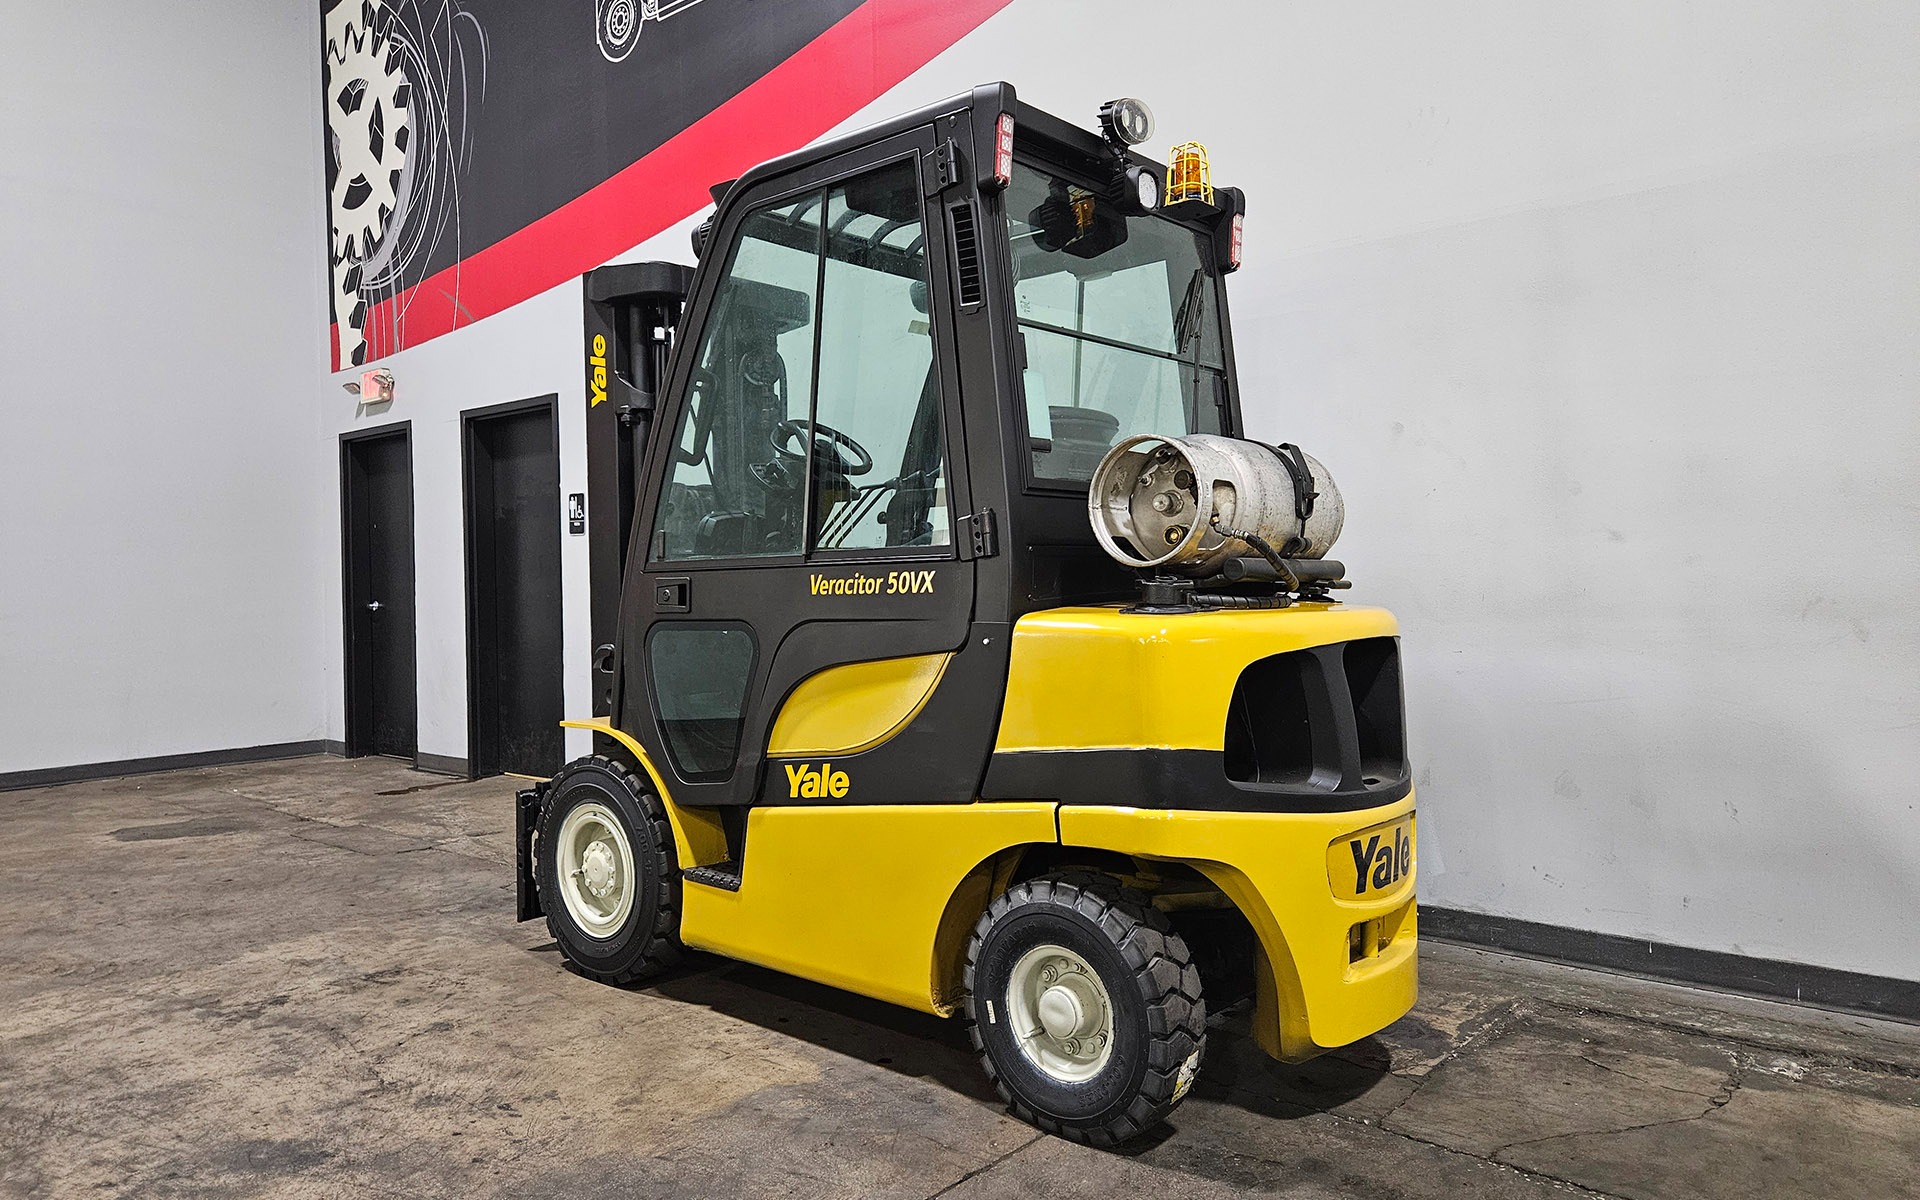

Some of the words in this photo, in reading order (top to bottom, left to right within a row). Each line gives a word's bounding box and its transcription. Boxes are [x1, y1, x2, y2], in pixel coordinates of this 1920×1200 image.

[590, 334, 607, 408] Yale
[810, 572, 884, 595] Veracitor
[886, 570, 936, 594] 50VX
[784, 763, 850, 798] Yale
[1350, 827, 1410, 895] Yale
